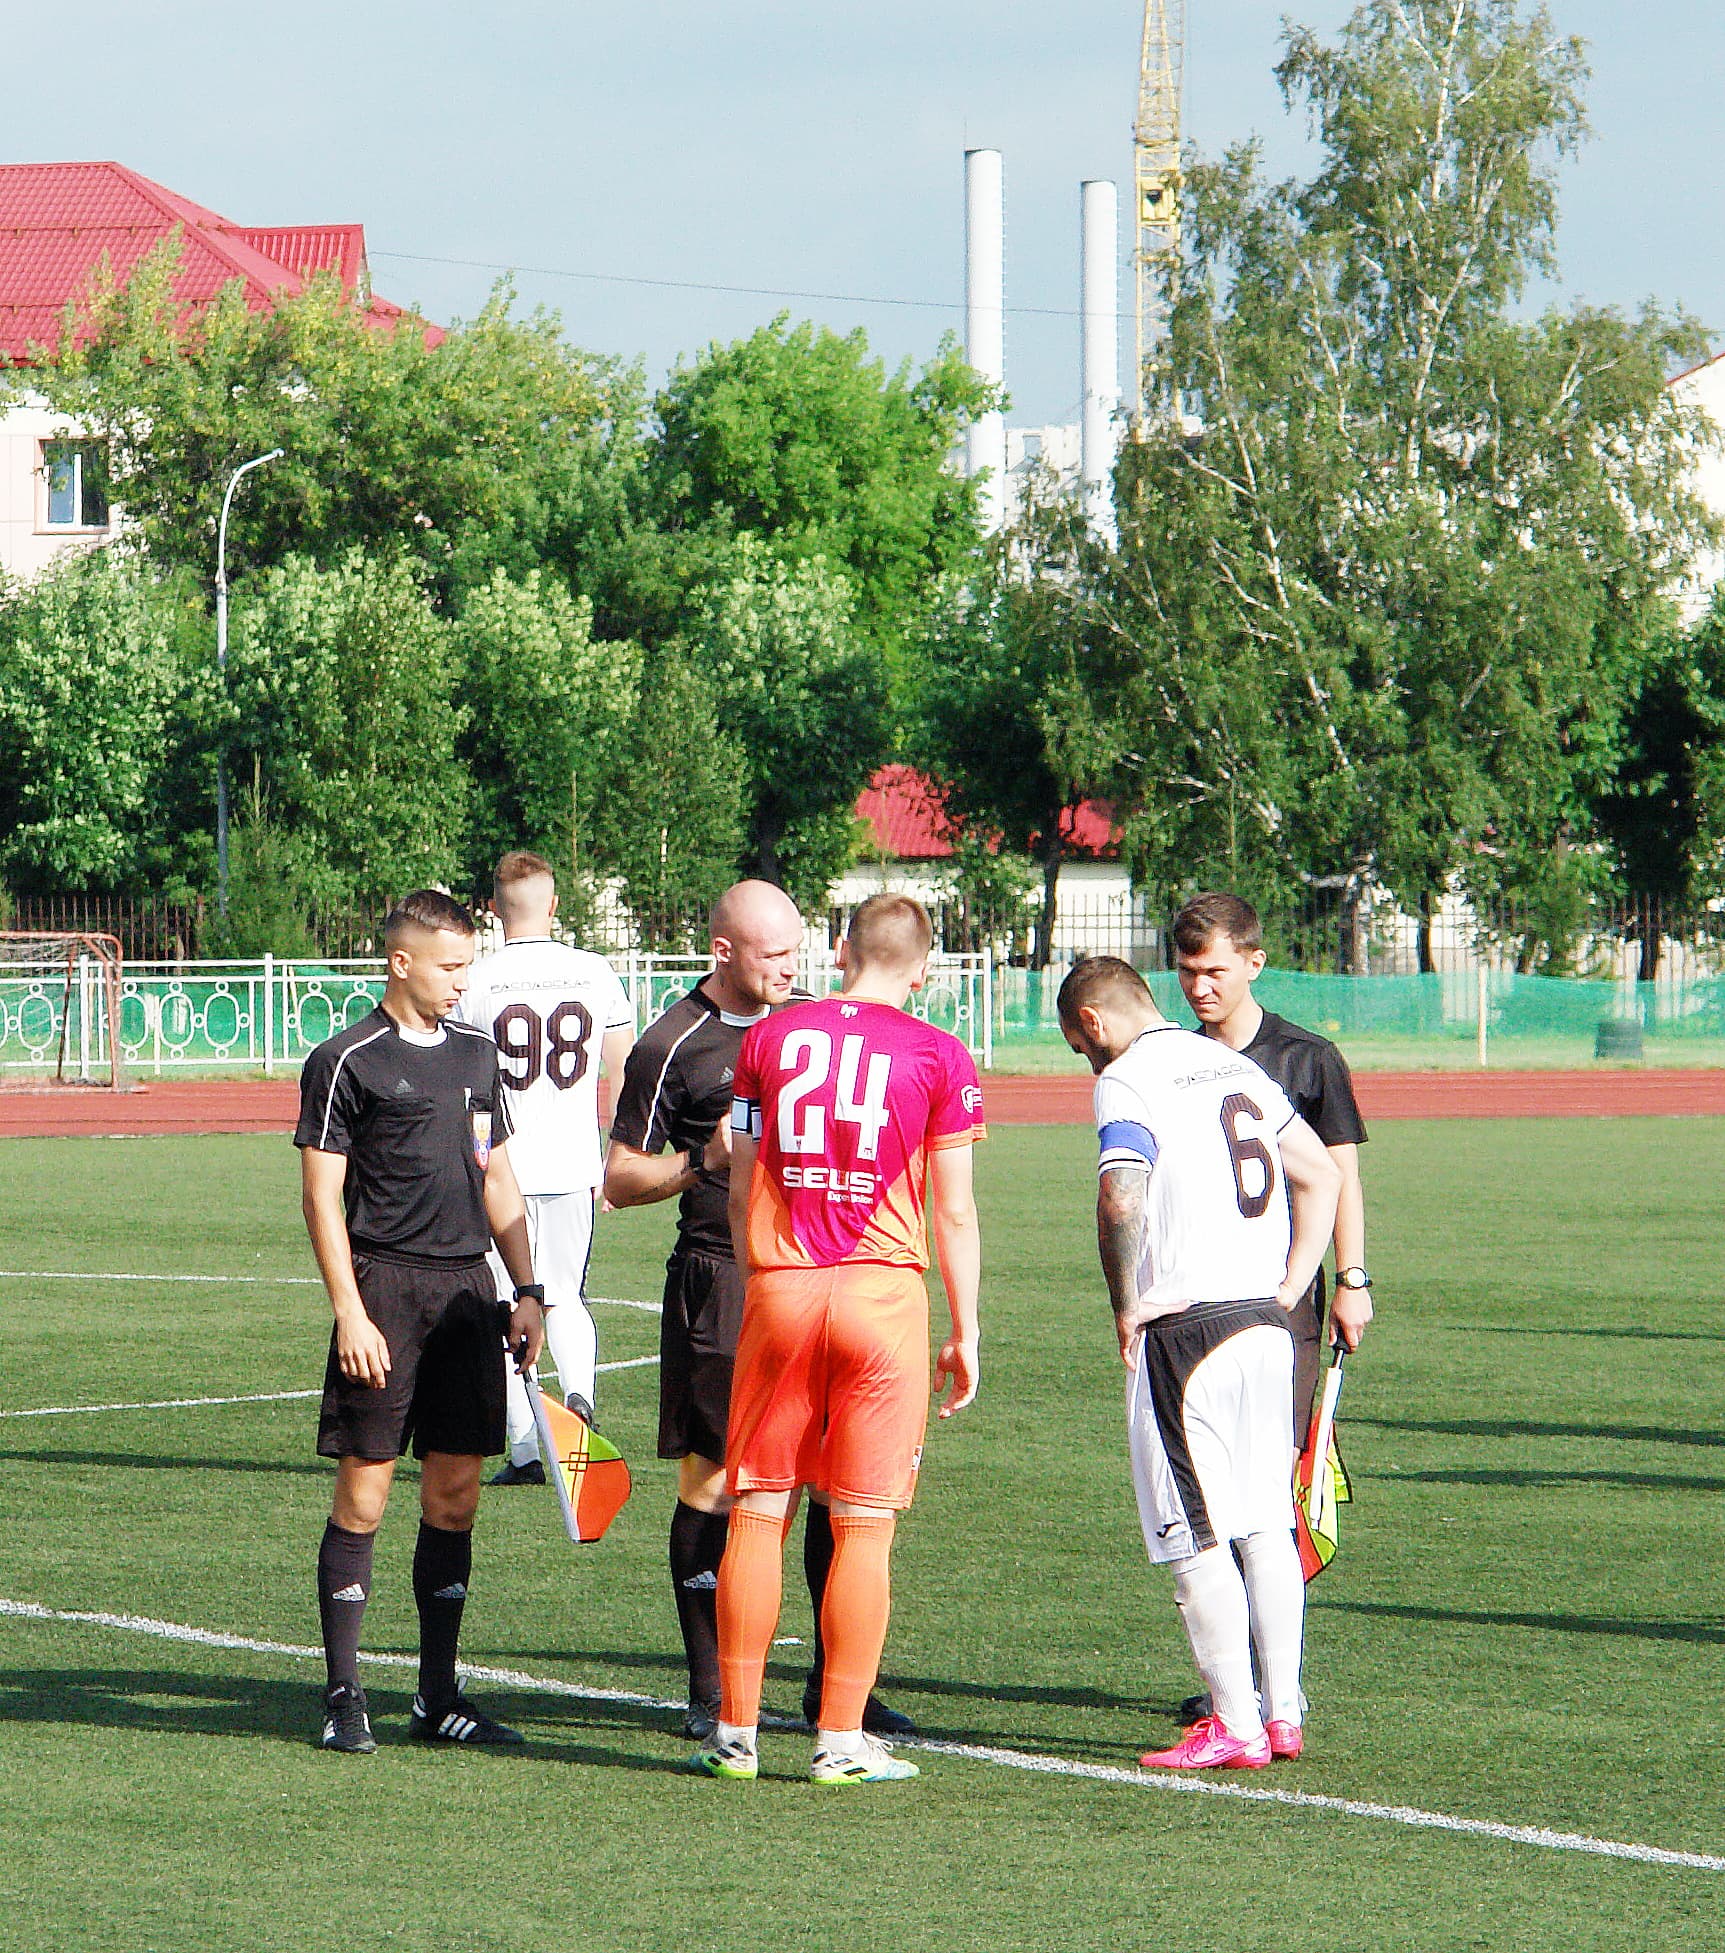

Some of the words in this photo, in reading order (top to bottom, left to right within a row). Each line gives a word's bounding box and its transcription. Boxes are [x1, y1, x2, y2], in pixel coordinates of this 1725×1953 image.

[493, 1001, 592, 1091] 98
[778, 1028, 892, 1161] 24
[782, 1166, 876, 1195] SEUS
[1220, 1092, 1275, 1219] 6
